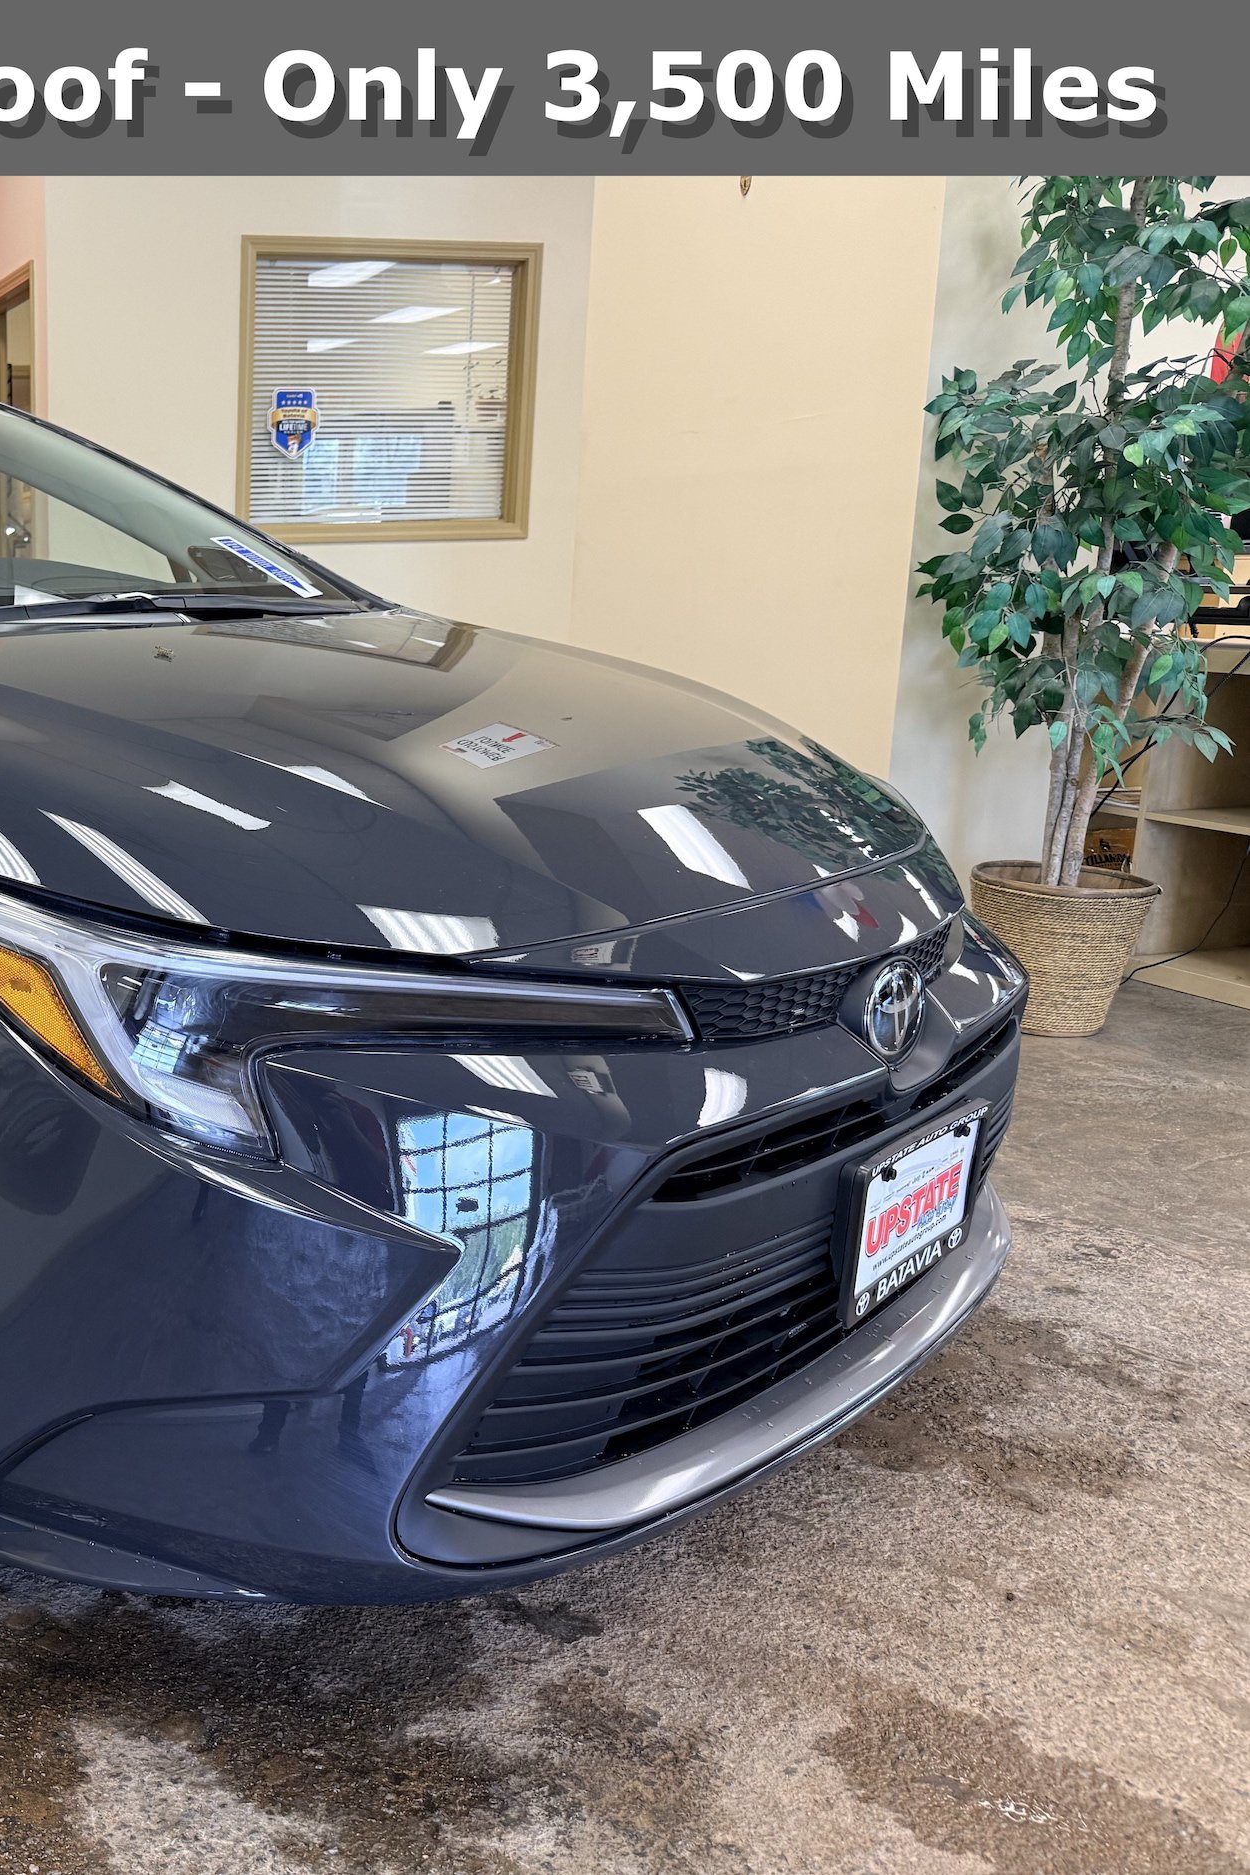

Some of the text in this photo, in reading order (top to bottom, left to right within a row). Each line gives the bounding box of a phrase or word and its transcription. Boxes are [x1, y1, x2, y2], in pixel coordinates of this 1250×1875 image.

[871, 1141, 918, 1178] UPSTATE
[916, 1125, 950, 1148] AUTO
[949, 1105, 989, 1130] GROUP
[864, 1159, 963, 1258] UPSTATE
[876, 1239, 943, 1302] BATAVIA
